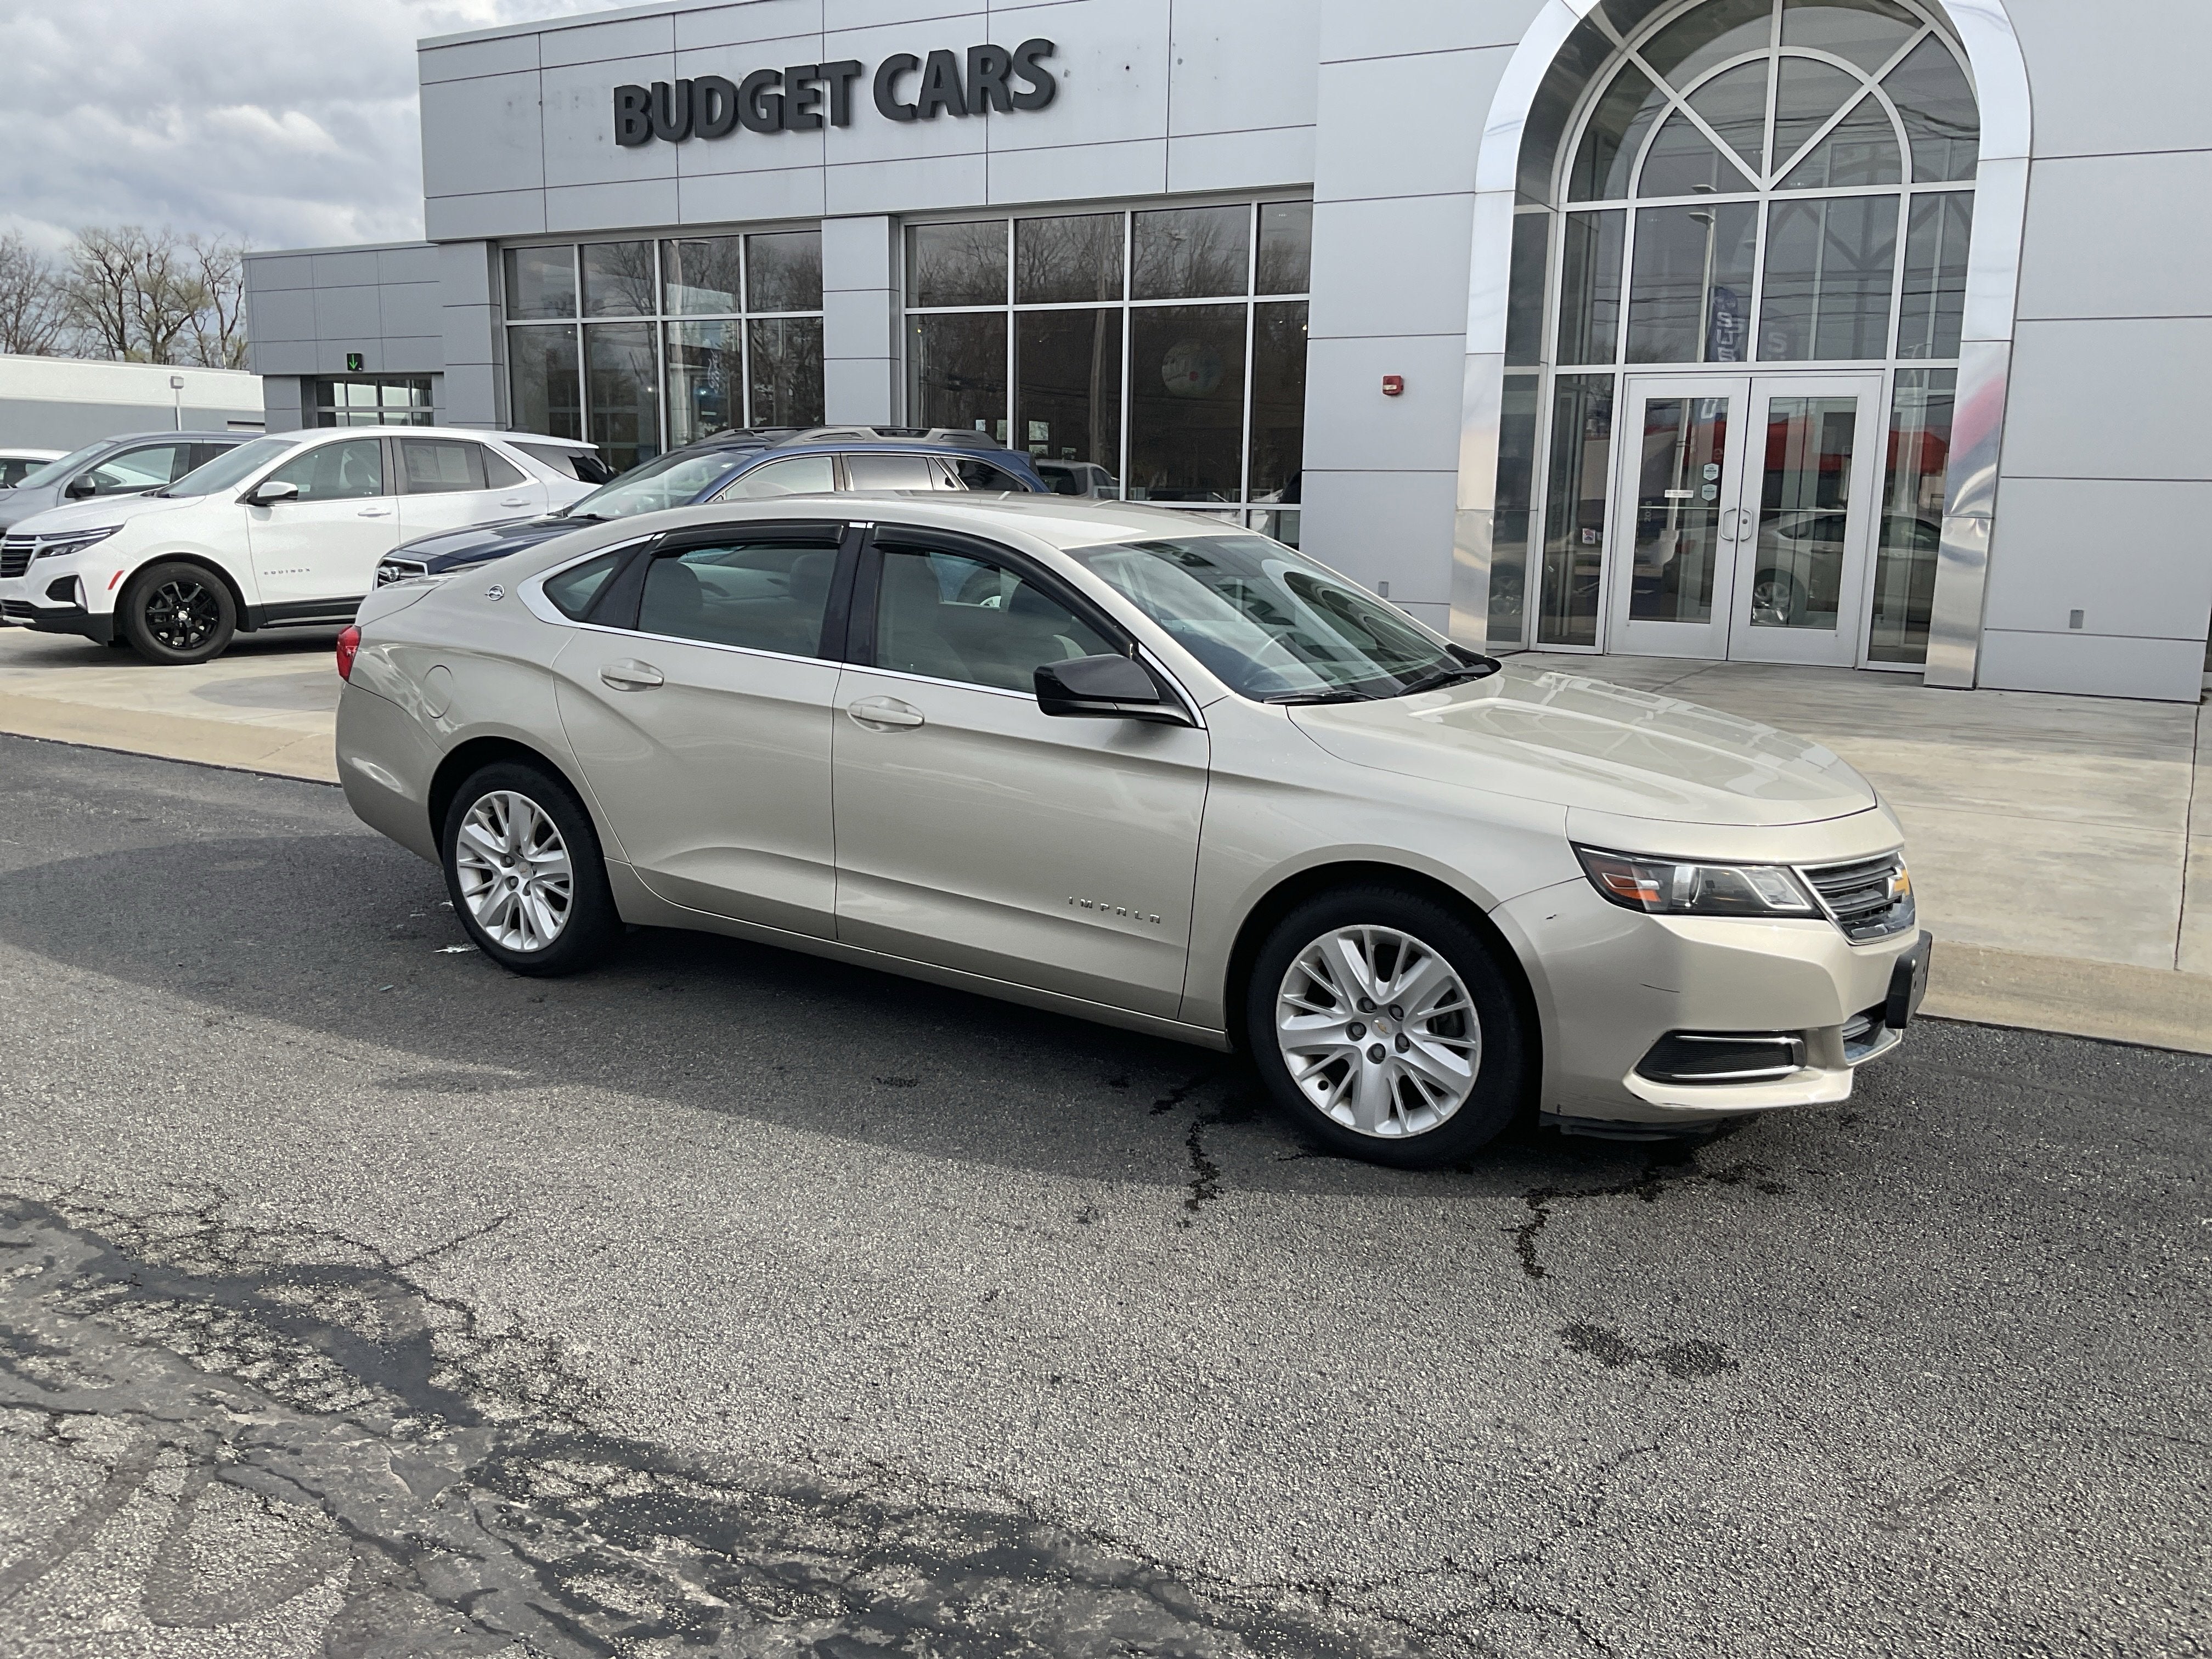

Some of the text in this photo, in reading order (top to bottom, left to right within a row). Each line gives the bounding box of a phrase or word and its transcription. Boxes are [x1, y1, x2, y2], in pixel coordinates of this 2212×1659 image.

[614, 38, 1055, 146] BUDGET CARS
[1068, 896, 1161, 924] IMPALA
